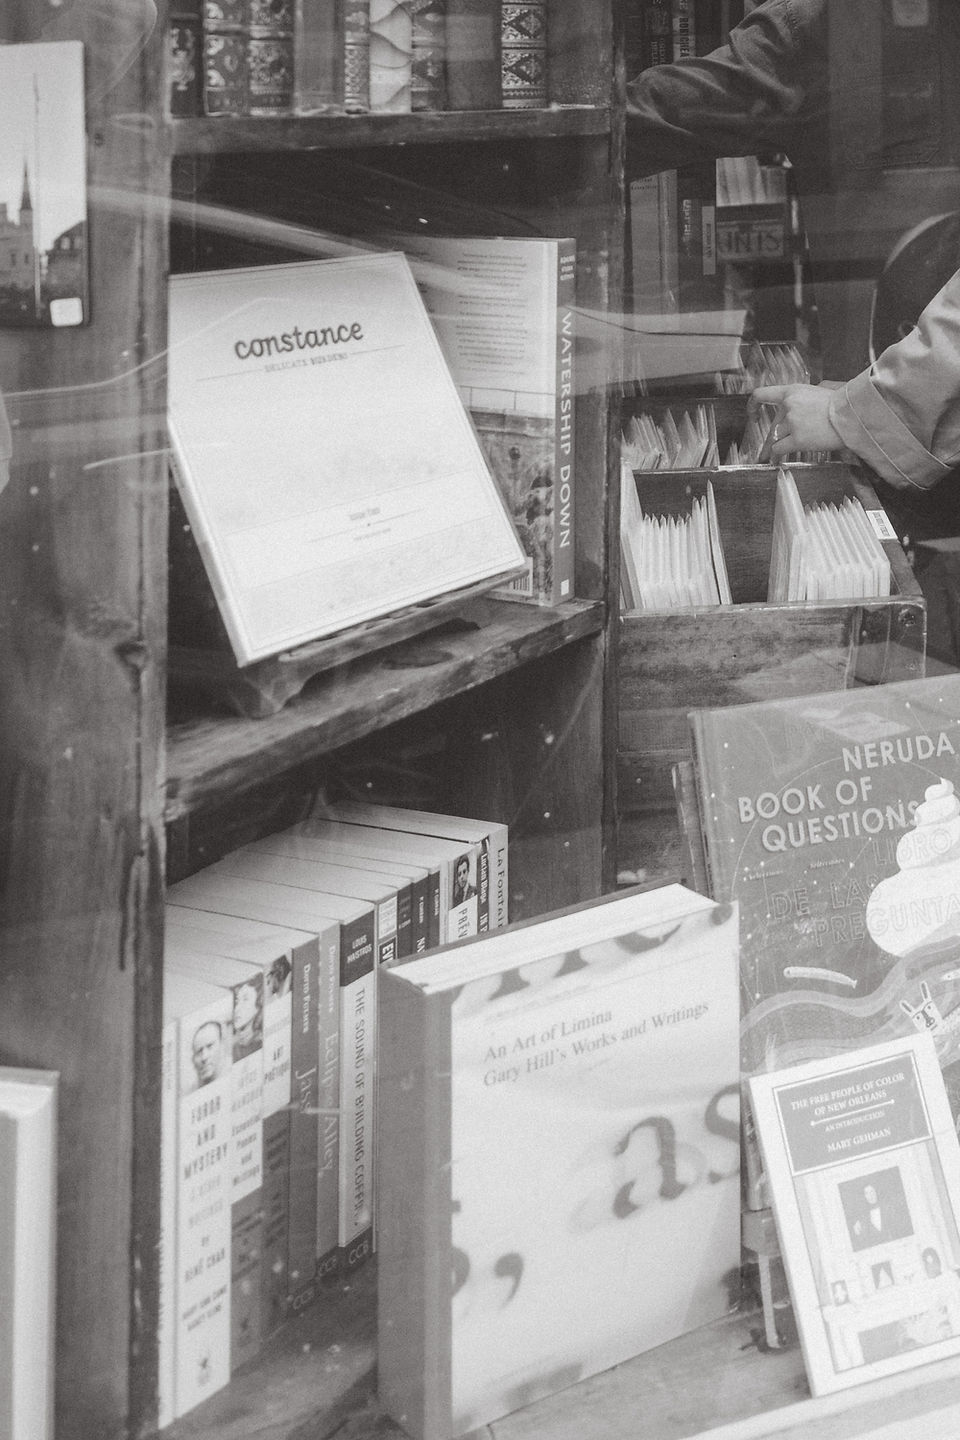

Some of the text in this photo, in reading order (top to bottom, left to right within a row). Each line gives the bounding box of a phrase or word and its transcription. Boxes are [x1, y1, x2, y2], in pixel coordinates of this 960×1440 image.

[679, 17, 690, 58] ROBICHEA
[234, 322, 364, 360] constance
[559, 312, 572, 549] WATERSHIP DOWN
[842, 731, 956, 773] NERUDA
[737, 775, 873, 823] BOOK OF
[761, 799, 921, 852] QUESTIONS
[497, 870, 505, 929] FONTAI
[457, 907, 470, 939] PRÉV
[355, 987, 366, 1015] THE
[355, 1019, 366, 1070] SOUND
[483, 1010, 613, 1063] An Art of Limina
[483, 1064, 521, 1088] Gary
[571, 1032, 618, 1056] Works
[621, 1020, 647, 1041] and
[650, 1003, 710, 1029] Writings
[355, 1072, 366, 1090] OF
[790, 1071, 905, 1111] THE FREE PEOPLE OF COLOR
[813, 1088, 888, 1117] OF NEW ORLEANS
[321, 1117, 338, 1171] Alley
[827, 1126, 892, 1153] MARY GEHMAN
